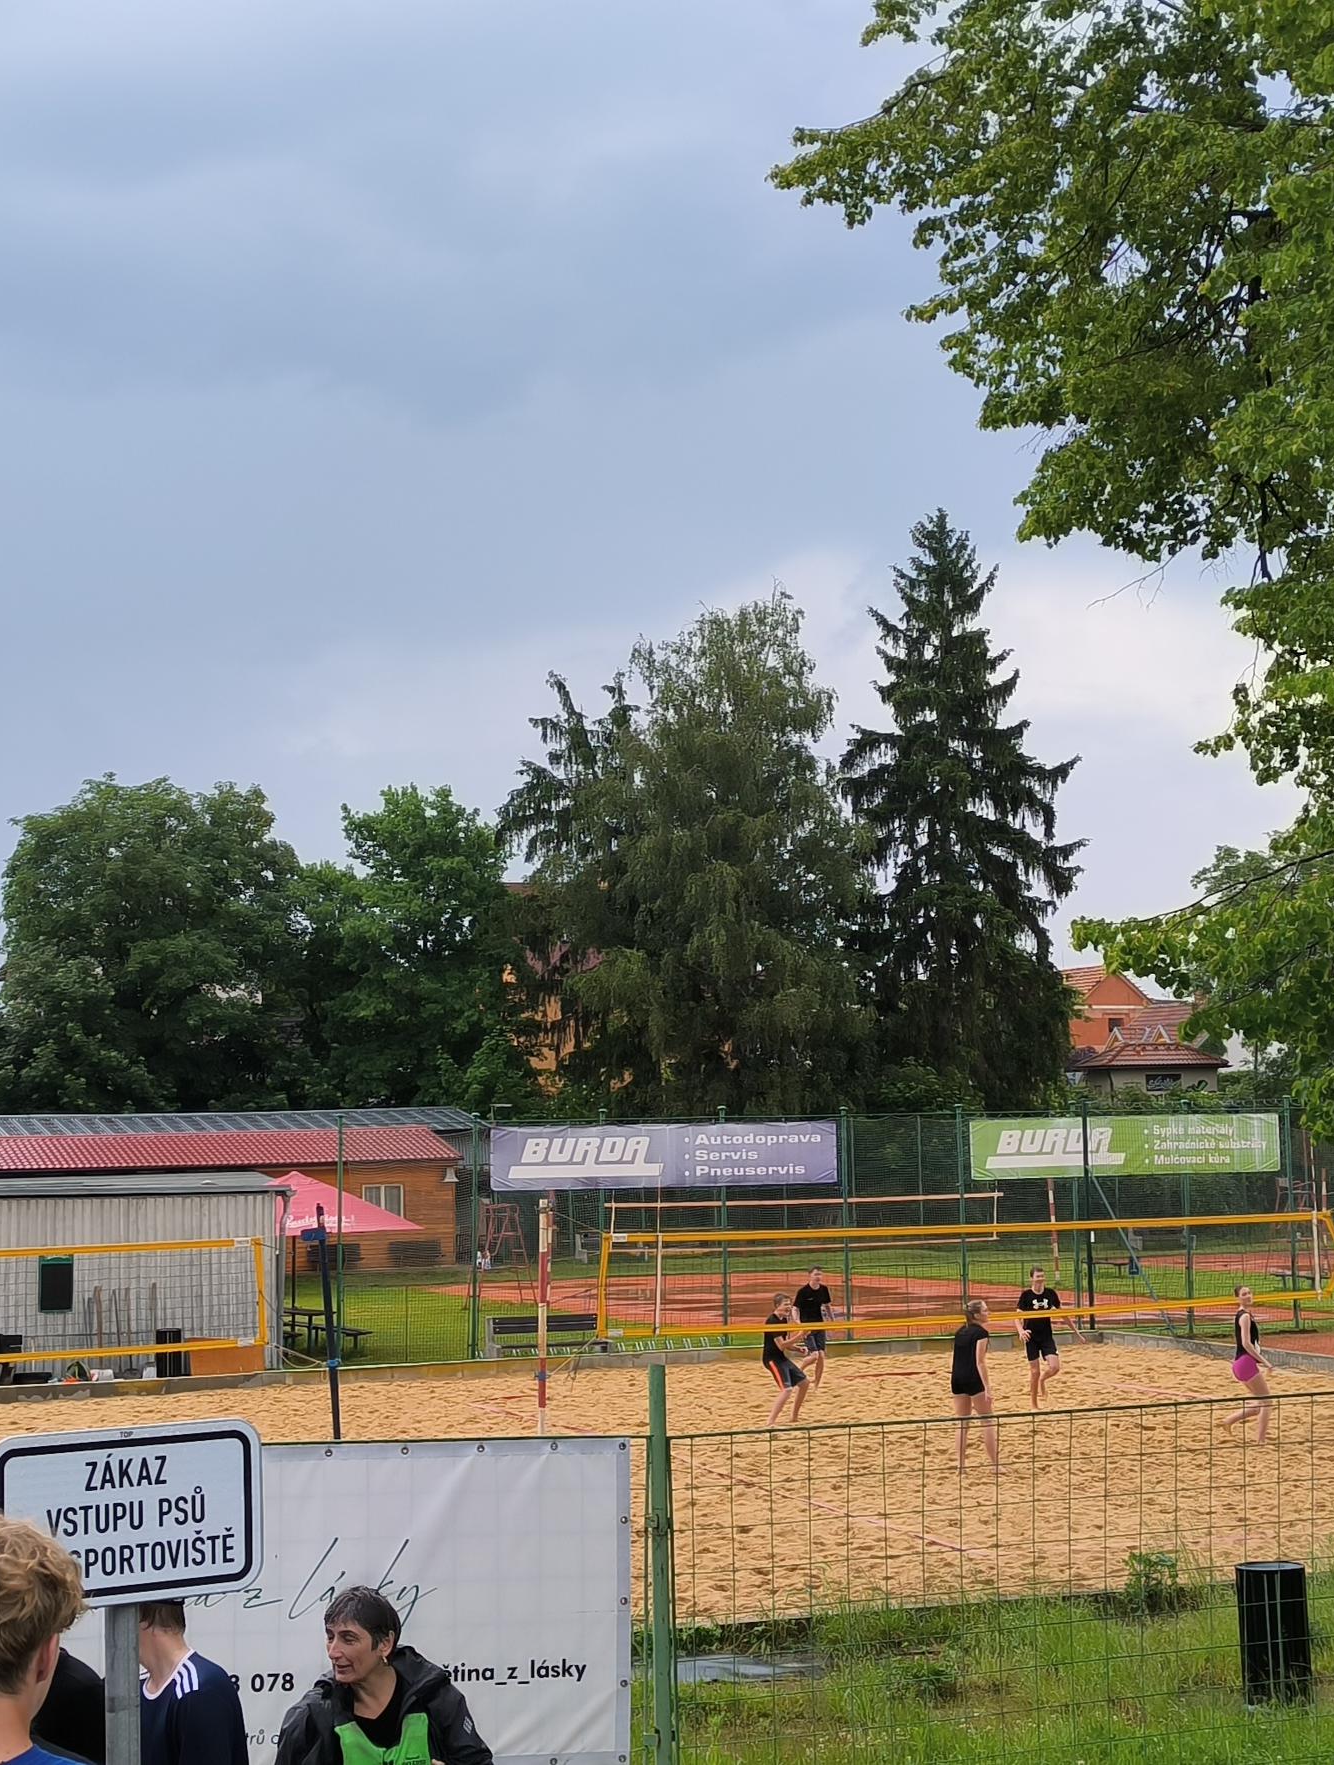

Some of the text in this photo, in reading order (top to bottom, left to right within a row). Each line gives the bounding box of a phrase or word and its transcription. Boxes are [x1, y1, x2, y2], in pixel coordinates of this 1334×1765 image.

[694, 1132, 822, 1146] Autodoprava
[520, 1136, 652, 1166] BURDA
[694, 1149, 758, 1161] Servis
[695, 1163, 806, 1177] Pneuservis
[84, 1453, 167, 1491] ZÁKAZ
[46, 1486, 205, 1537] VSTUPU PSŮ
[250, 1672, 295, 1693] 078
